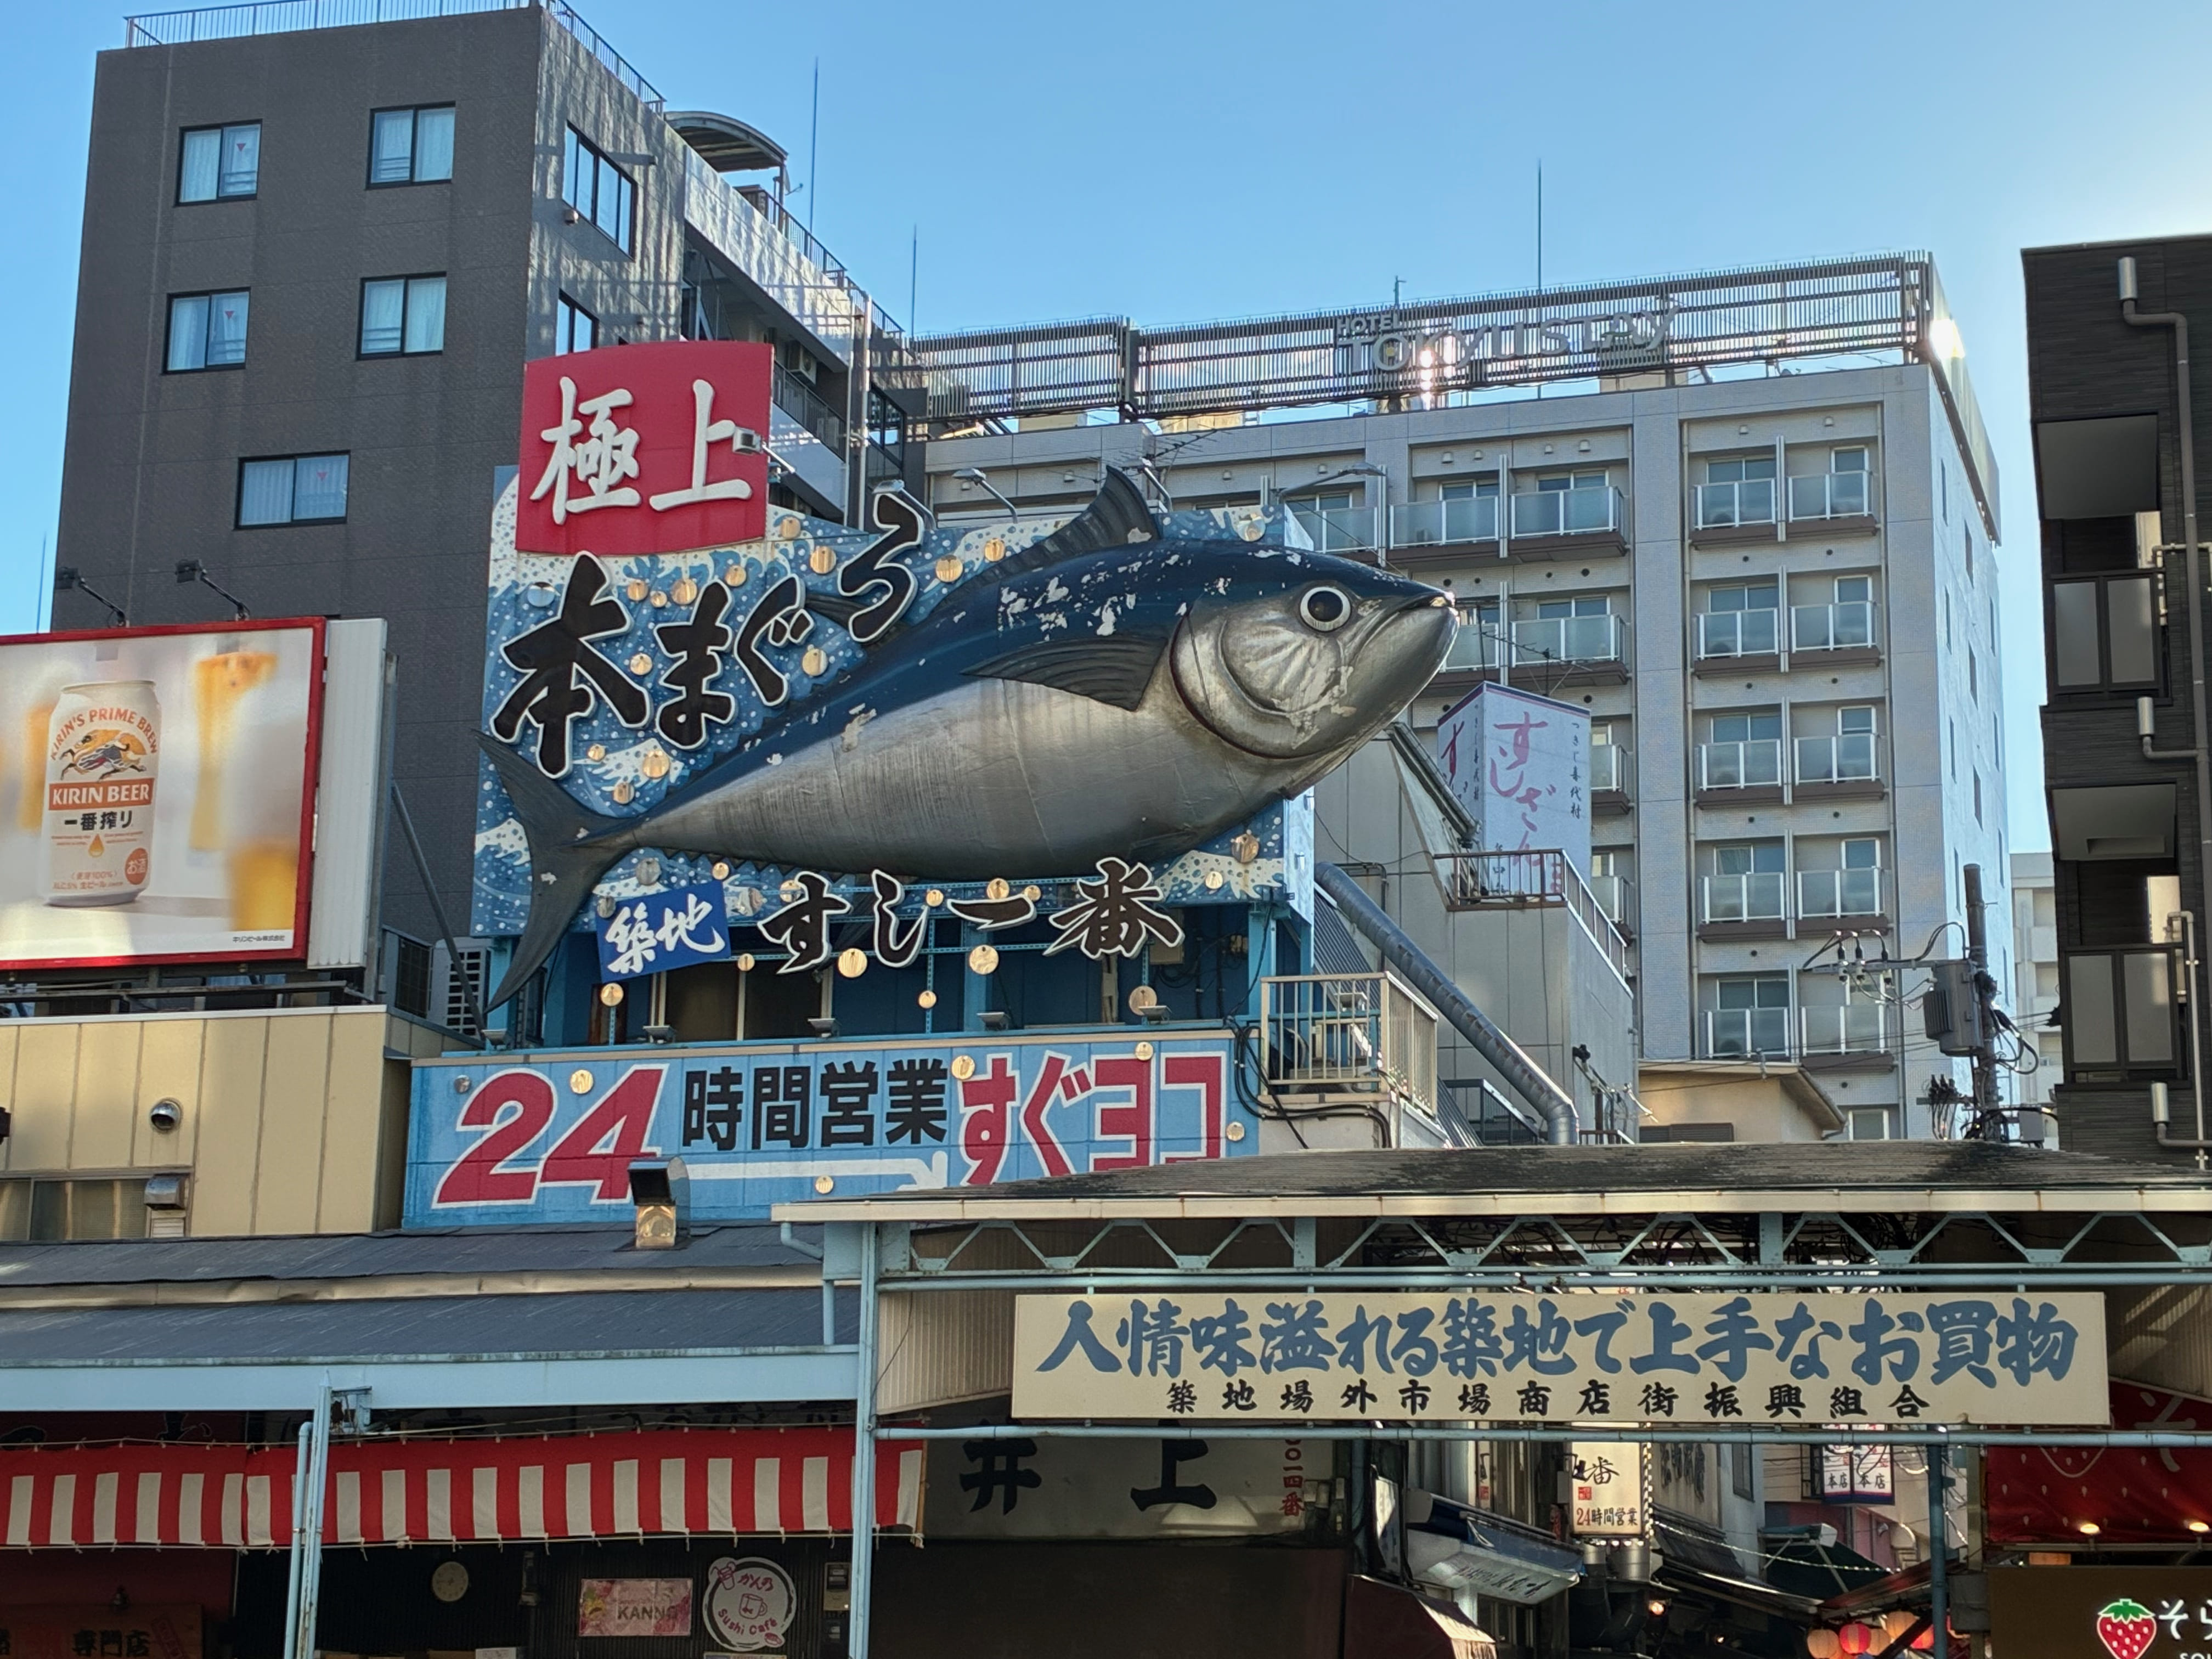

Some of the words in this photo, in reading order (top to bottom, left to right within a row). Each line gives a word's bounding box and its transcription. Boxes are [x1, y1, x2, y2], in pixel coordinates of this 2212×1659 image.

[1336, 313, 1401, 335] HOTEL
[530, 376, 752, 525] 極上
[490, 494, 924, 779] 本まぐろ
[50, 714, 85, 760] KIRIN'S
[89, 707, 137, 724] PRIME
[137, 716, 158, 754] BREW
[53, 787, 103, 805] KIRIN
[107, 784, 150, 802] BEER
[65, 810, 132, 831] 一番搾り
[606, 893, 724, 973] 築地
[759, 857, 1183, 973] すし一番
[1035, 1297, 2079, 1389] 人情味溢れる築地で上手なお買物
[1166, 1378, 1930, 1420] 築地場外市場商店街振興組合
[958, 1419, 1218, 1516] 井上
[1827, 1472, 1848, 1489] 本店
[1859, 1472, 1886, 1489] 本店
[1576, 1507, 1638, 1526] 24時間営業
[718, 1609, 745, 1635] Sushi
